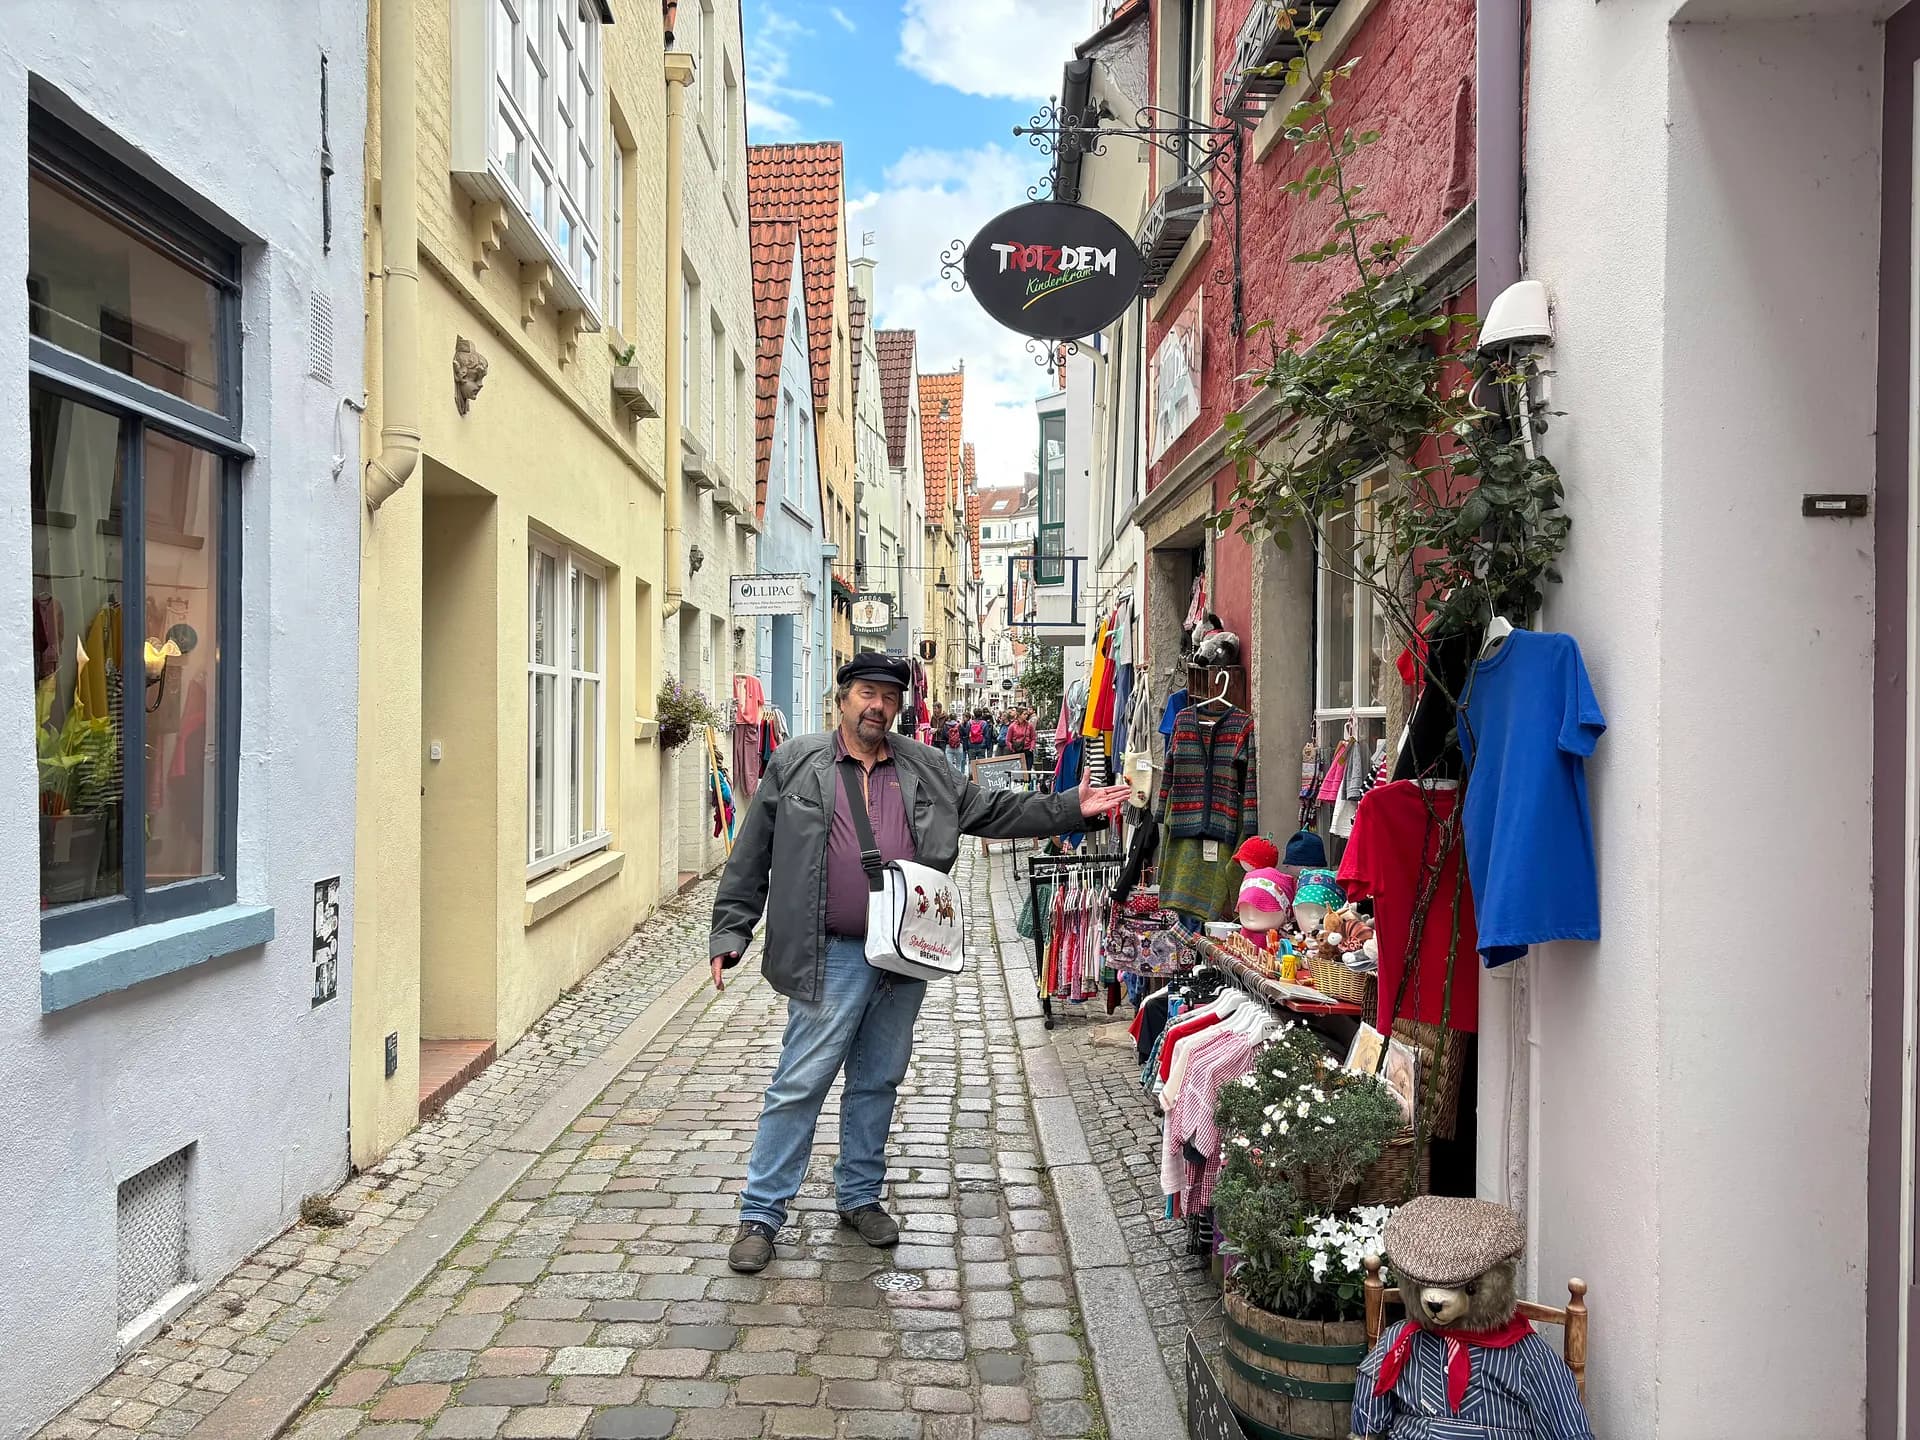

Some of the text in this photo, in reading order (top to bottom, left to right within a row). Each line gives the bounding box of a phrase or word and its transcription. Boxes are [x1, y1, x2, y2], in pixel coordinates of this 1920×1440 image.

[991, 241, 1117, 277] TROTZDEM
[1026, 267, 1092, 296] Kinderkram
[741, 583, 794, 597] OLLIPAC
[920, 950, 940, 961] BREMEN
